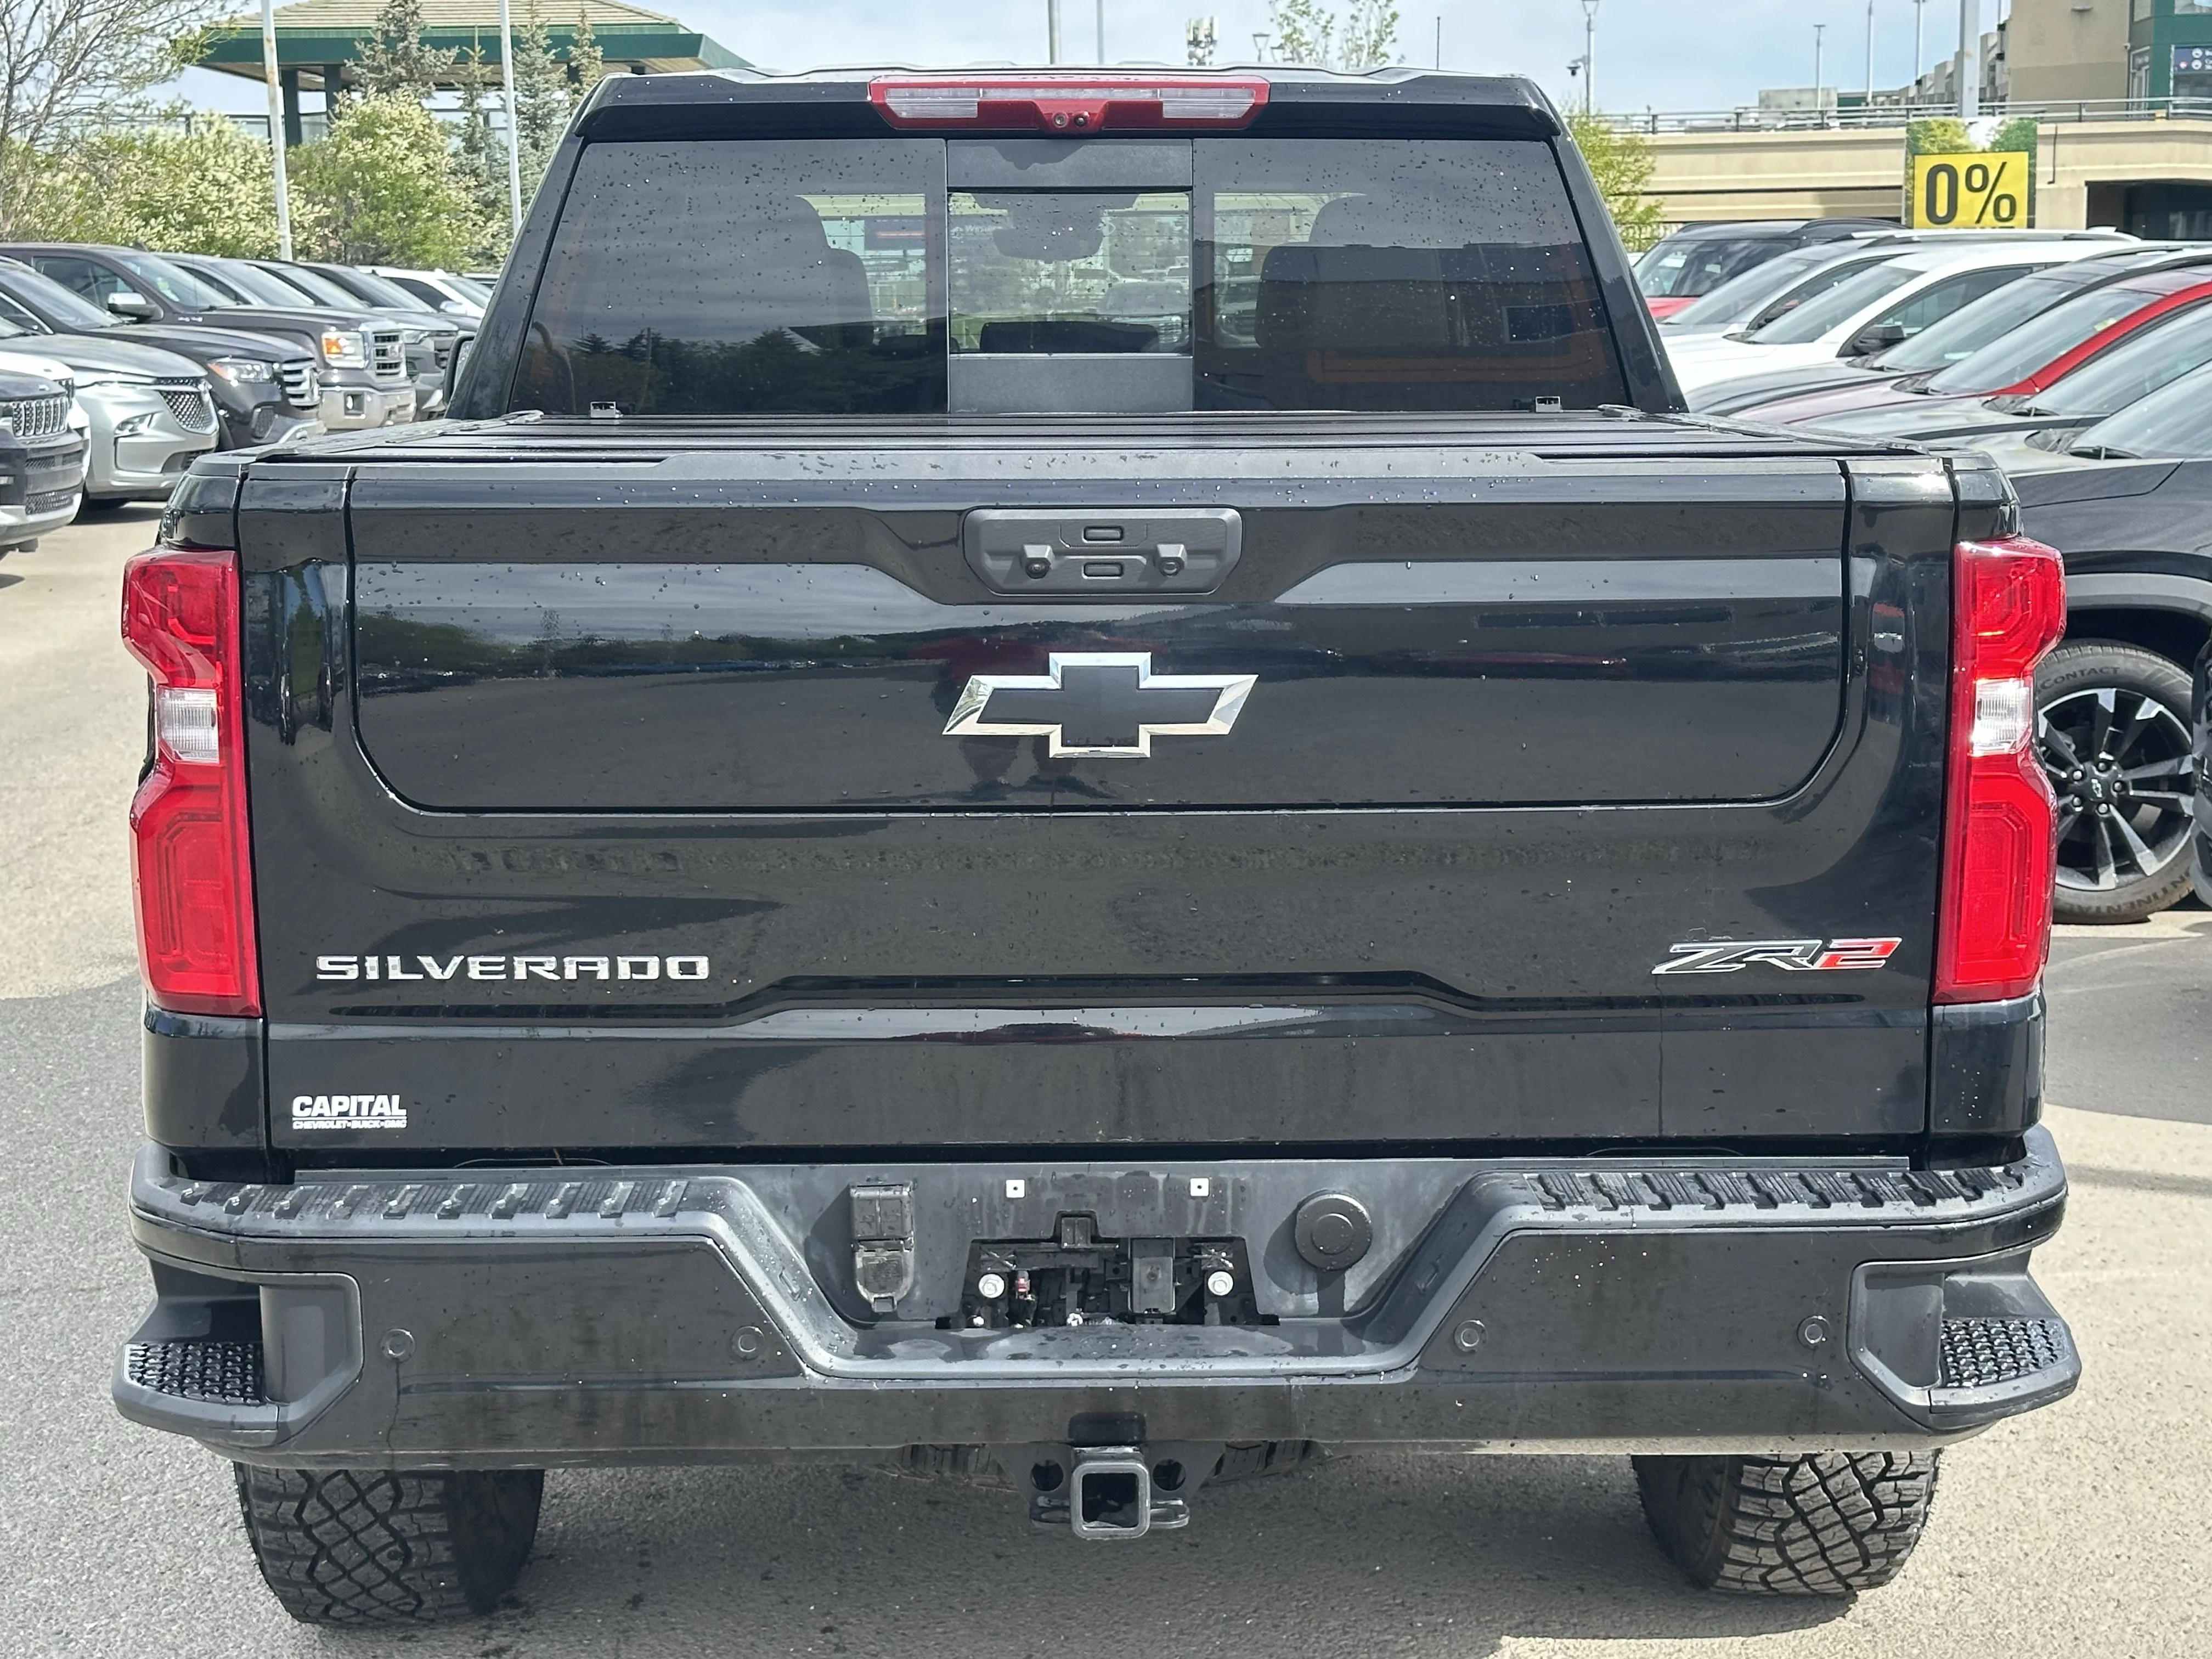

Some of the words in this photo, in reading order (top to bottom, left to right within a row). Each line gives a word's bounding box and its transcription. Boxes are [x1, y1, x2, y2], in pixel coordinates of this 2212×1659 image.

[1926, 162, 2017, 225] 0%
[316, 955, 711, 981] SILVERADO
[1651, 937, 1903, 975] ZR2
[292, 1094, 407, 1117] CAPITAL
